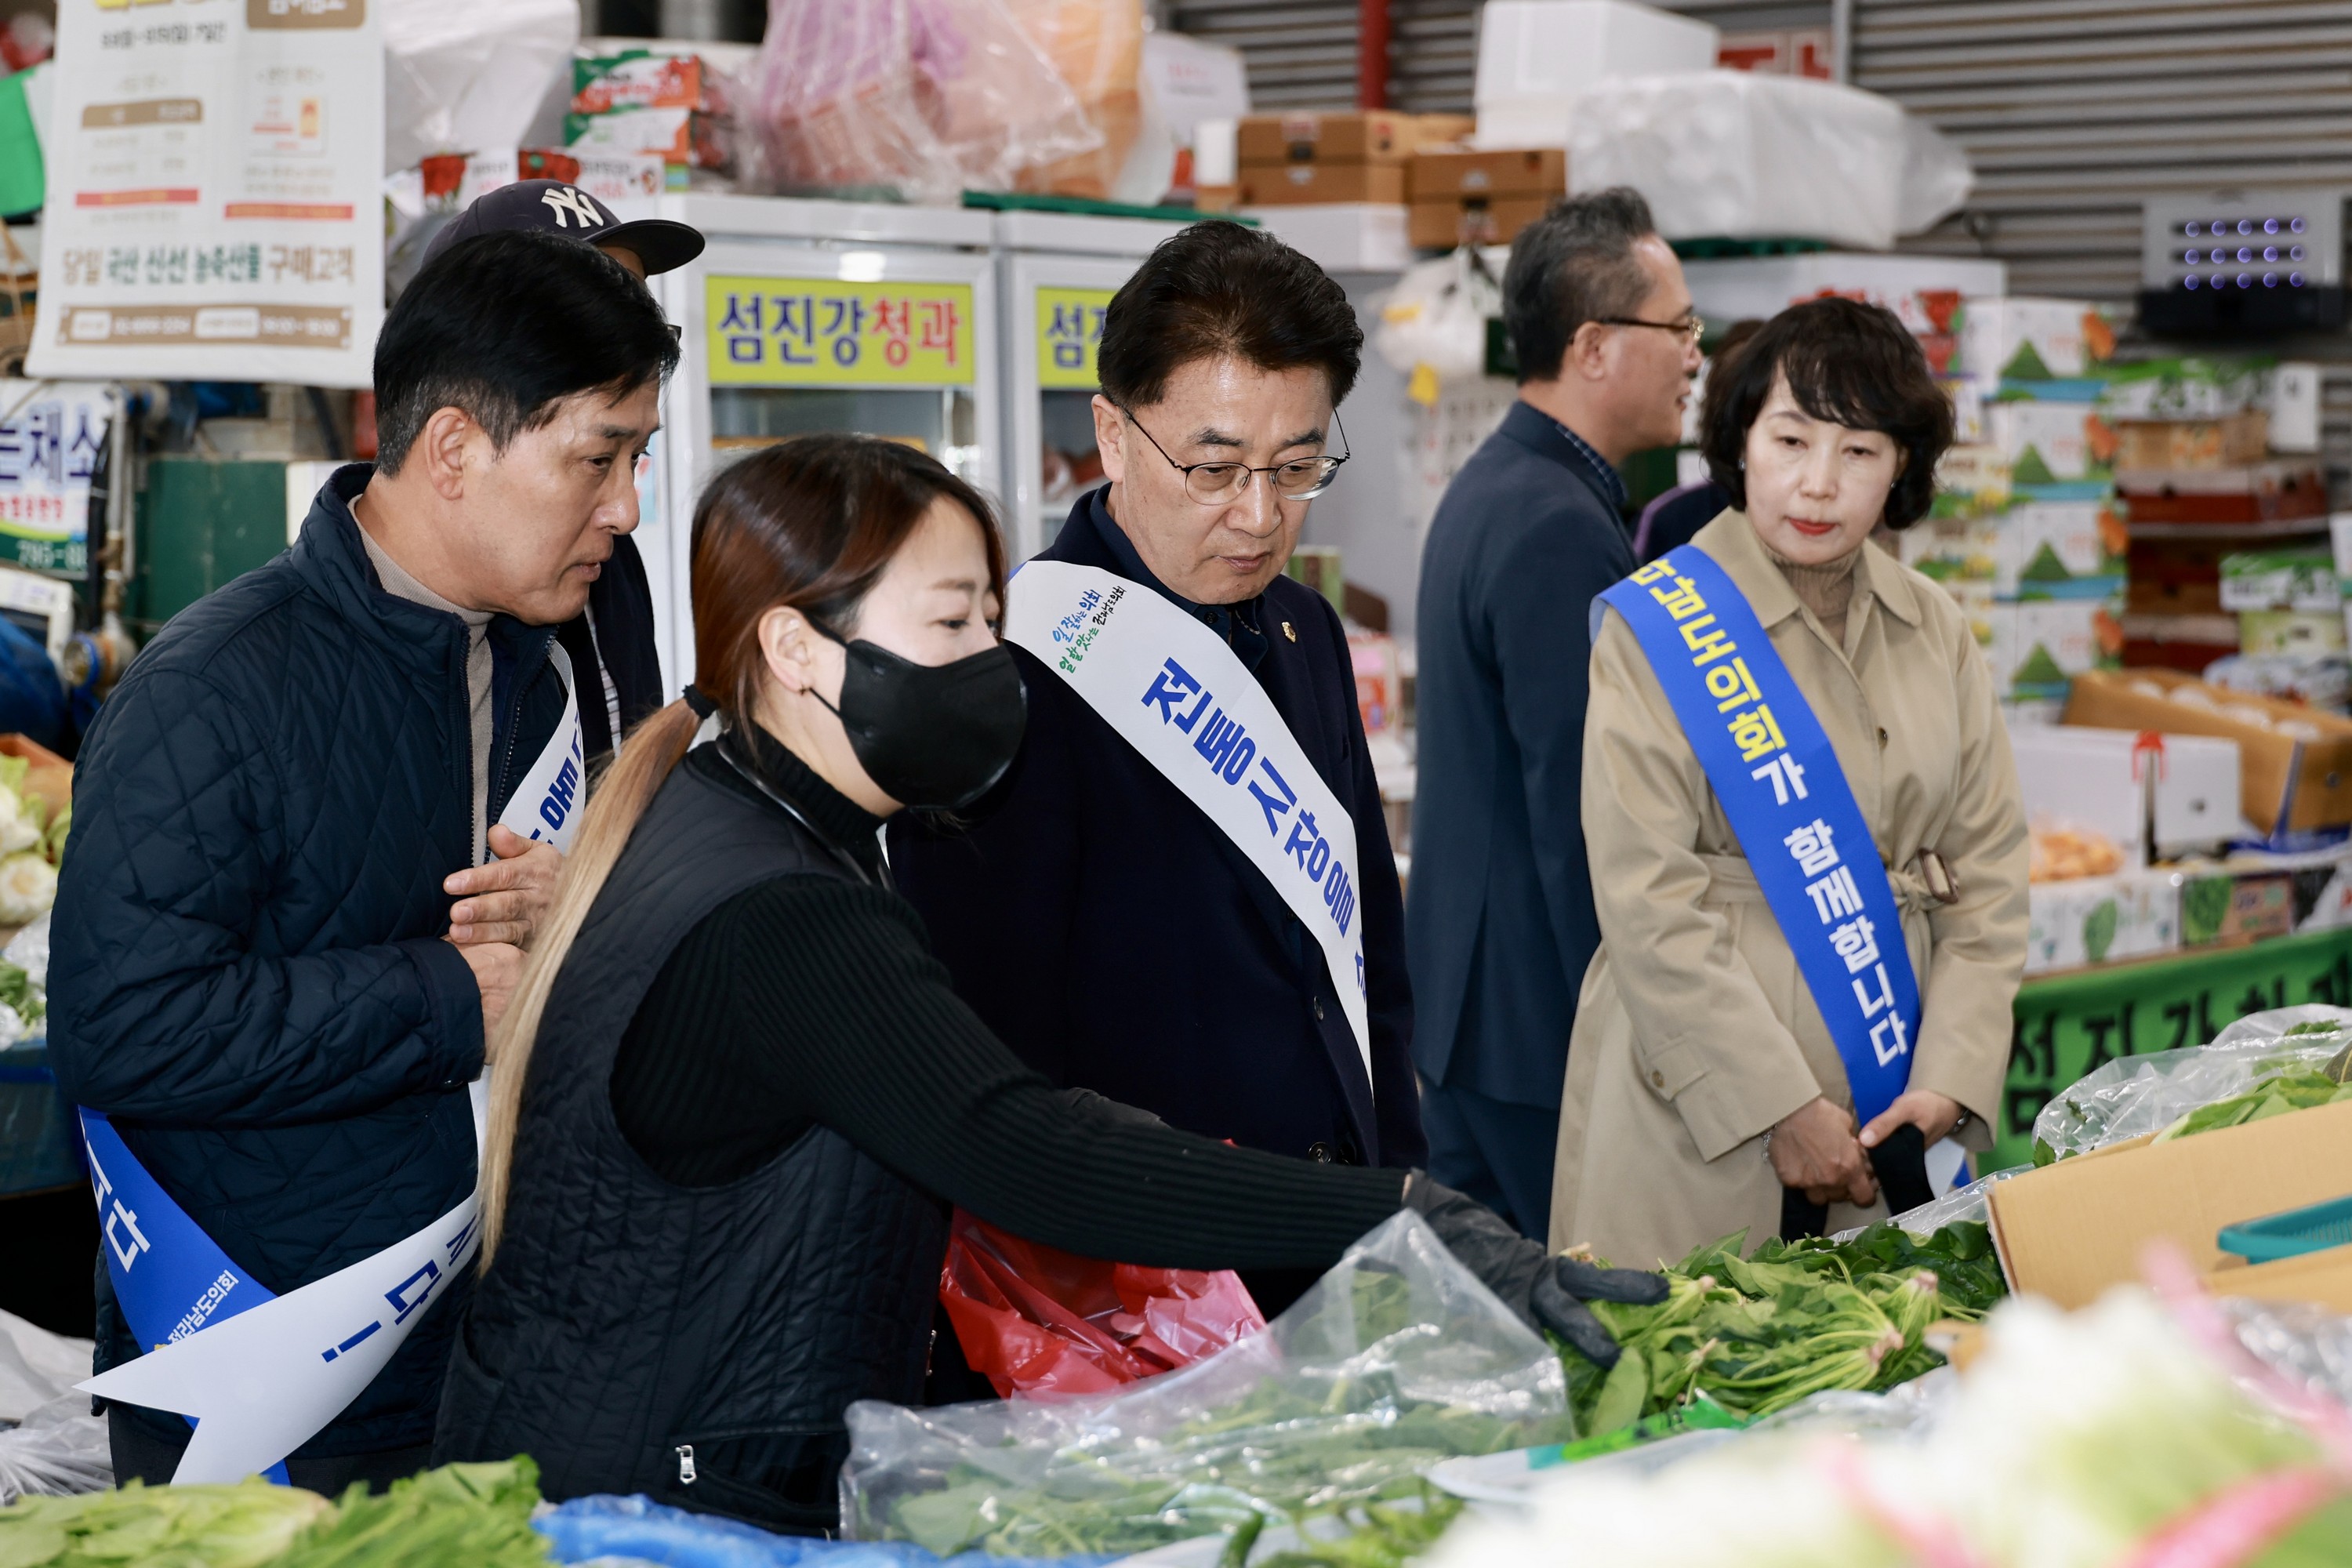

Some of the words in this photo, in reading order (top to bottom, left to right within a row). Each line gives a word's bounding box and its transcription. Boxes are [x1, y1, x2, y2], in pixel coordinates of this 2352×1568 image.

[541, 187, 604, 228] NY
[63, 247, 103, 286] 당일
[107, 246, 140, 285] 국산
[145, 245, 188, 284] 신선
[194, 243, 261, 284] 농축산물
[718, 293, 960, 368] 섬진강청과
[1061, 611, 1087, 630] 잘하는
[1079, 589, 1103, 611] 의회
[1092, 586, 1127, 626] 전라남도의회
[1052, 626, 1074, 642] 일
[1141, 656, 1356, 938] 전통시장을
[1783, 818, 1908, 1068] 함께합니다
